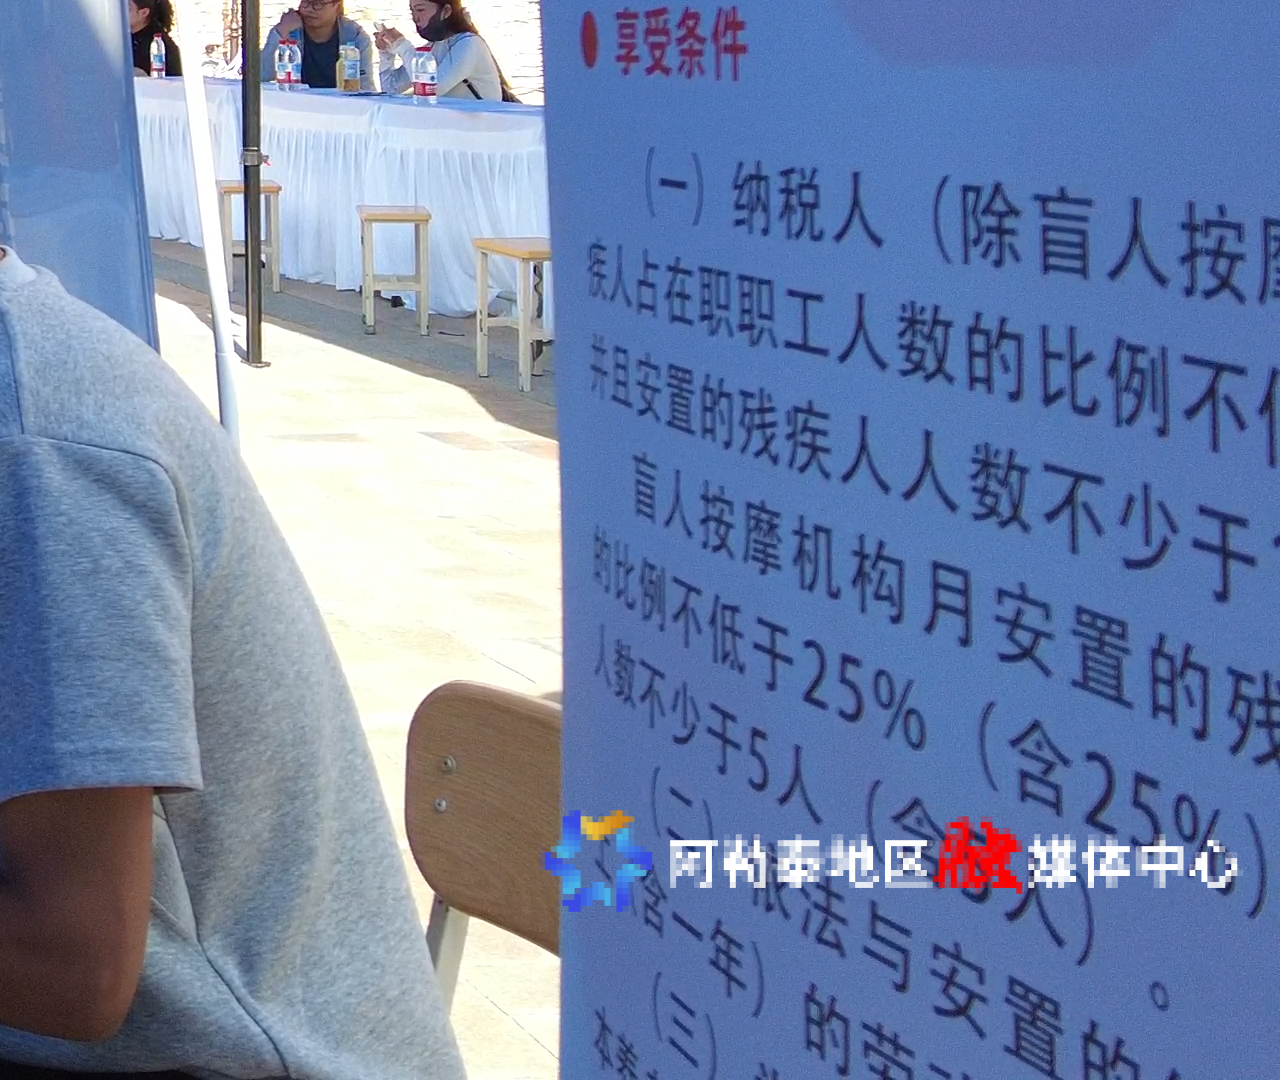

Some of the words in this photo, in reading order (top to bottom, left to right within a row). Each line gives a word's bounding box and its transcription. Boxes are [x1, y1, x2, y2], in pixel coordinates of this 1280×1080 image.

[613, 6, 749, 82] 享受条件
[587, 236, 1280, 470] 疾人占在职职工人数的比例不
[589, 332, 1280, 604] 并且安置的残疾人人数不少于
